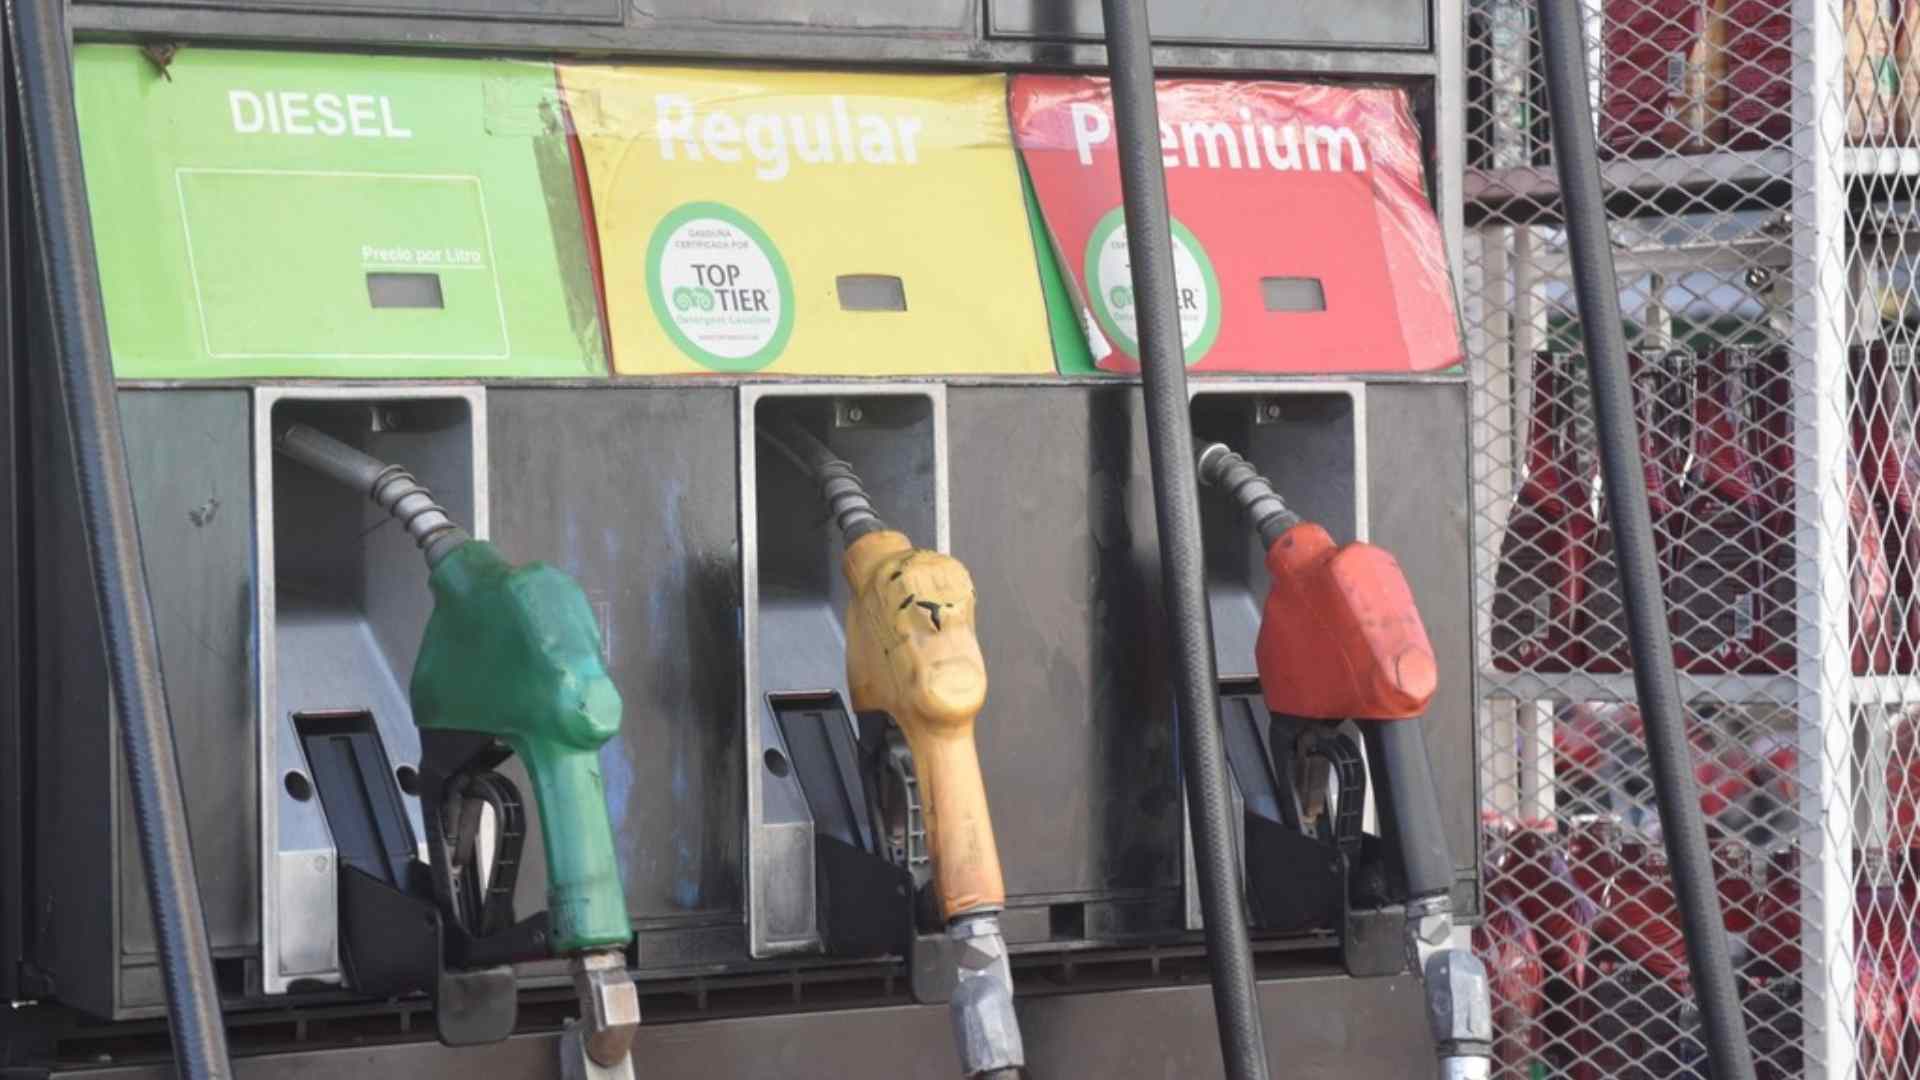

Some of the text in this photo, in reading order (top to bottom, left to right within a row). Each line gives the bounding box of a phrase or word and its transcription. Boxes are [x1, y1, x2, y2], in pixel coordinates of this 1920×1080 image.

[228, 90, 412, 138] DIESEL
[654, 93, 922, 181] Regular
[1070, 101, 1367, 172] Pemium
[361, 245, 481, 265] Precio por Litro
[691, 264, 740, 287] TOP
[715, 289, 769, 311] TIER
